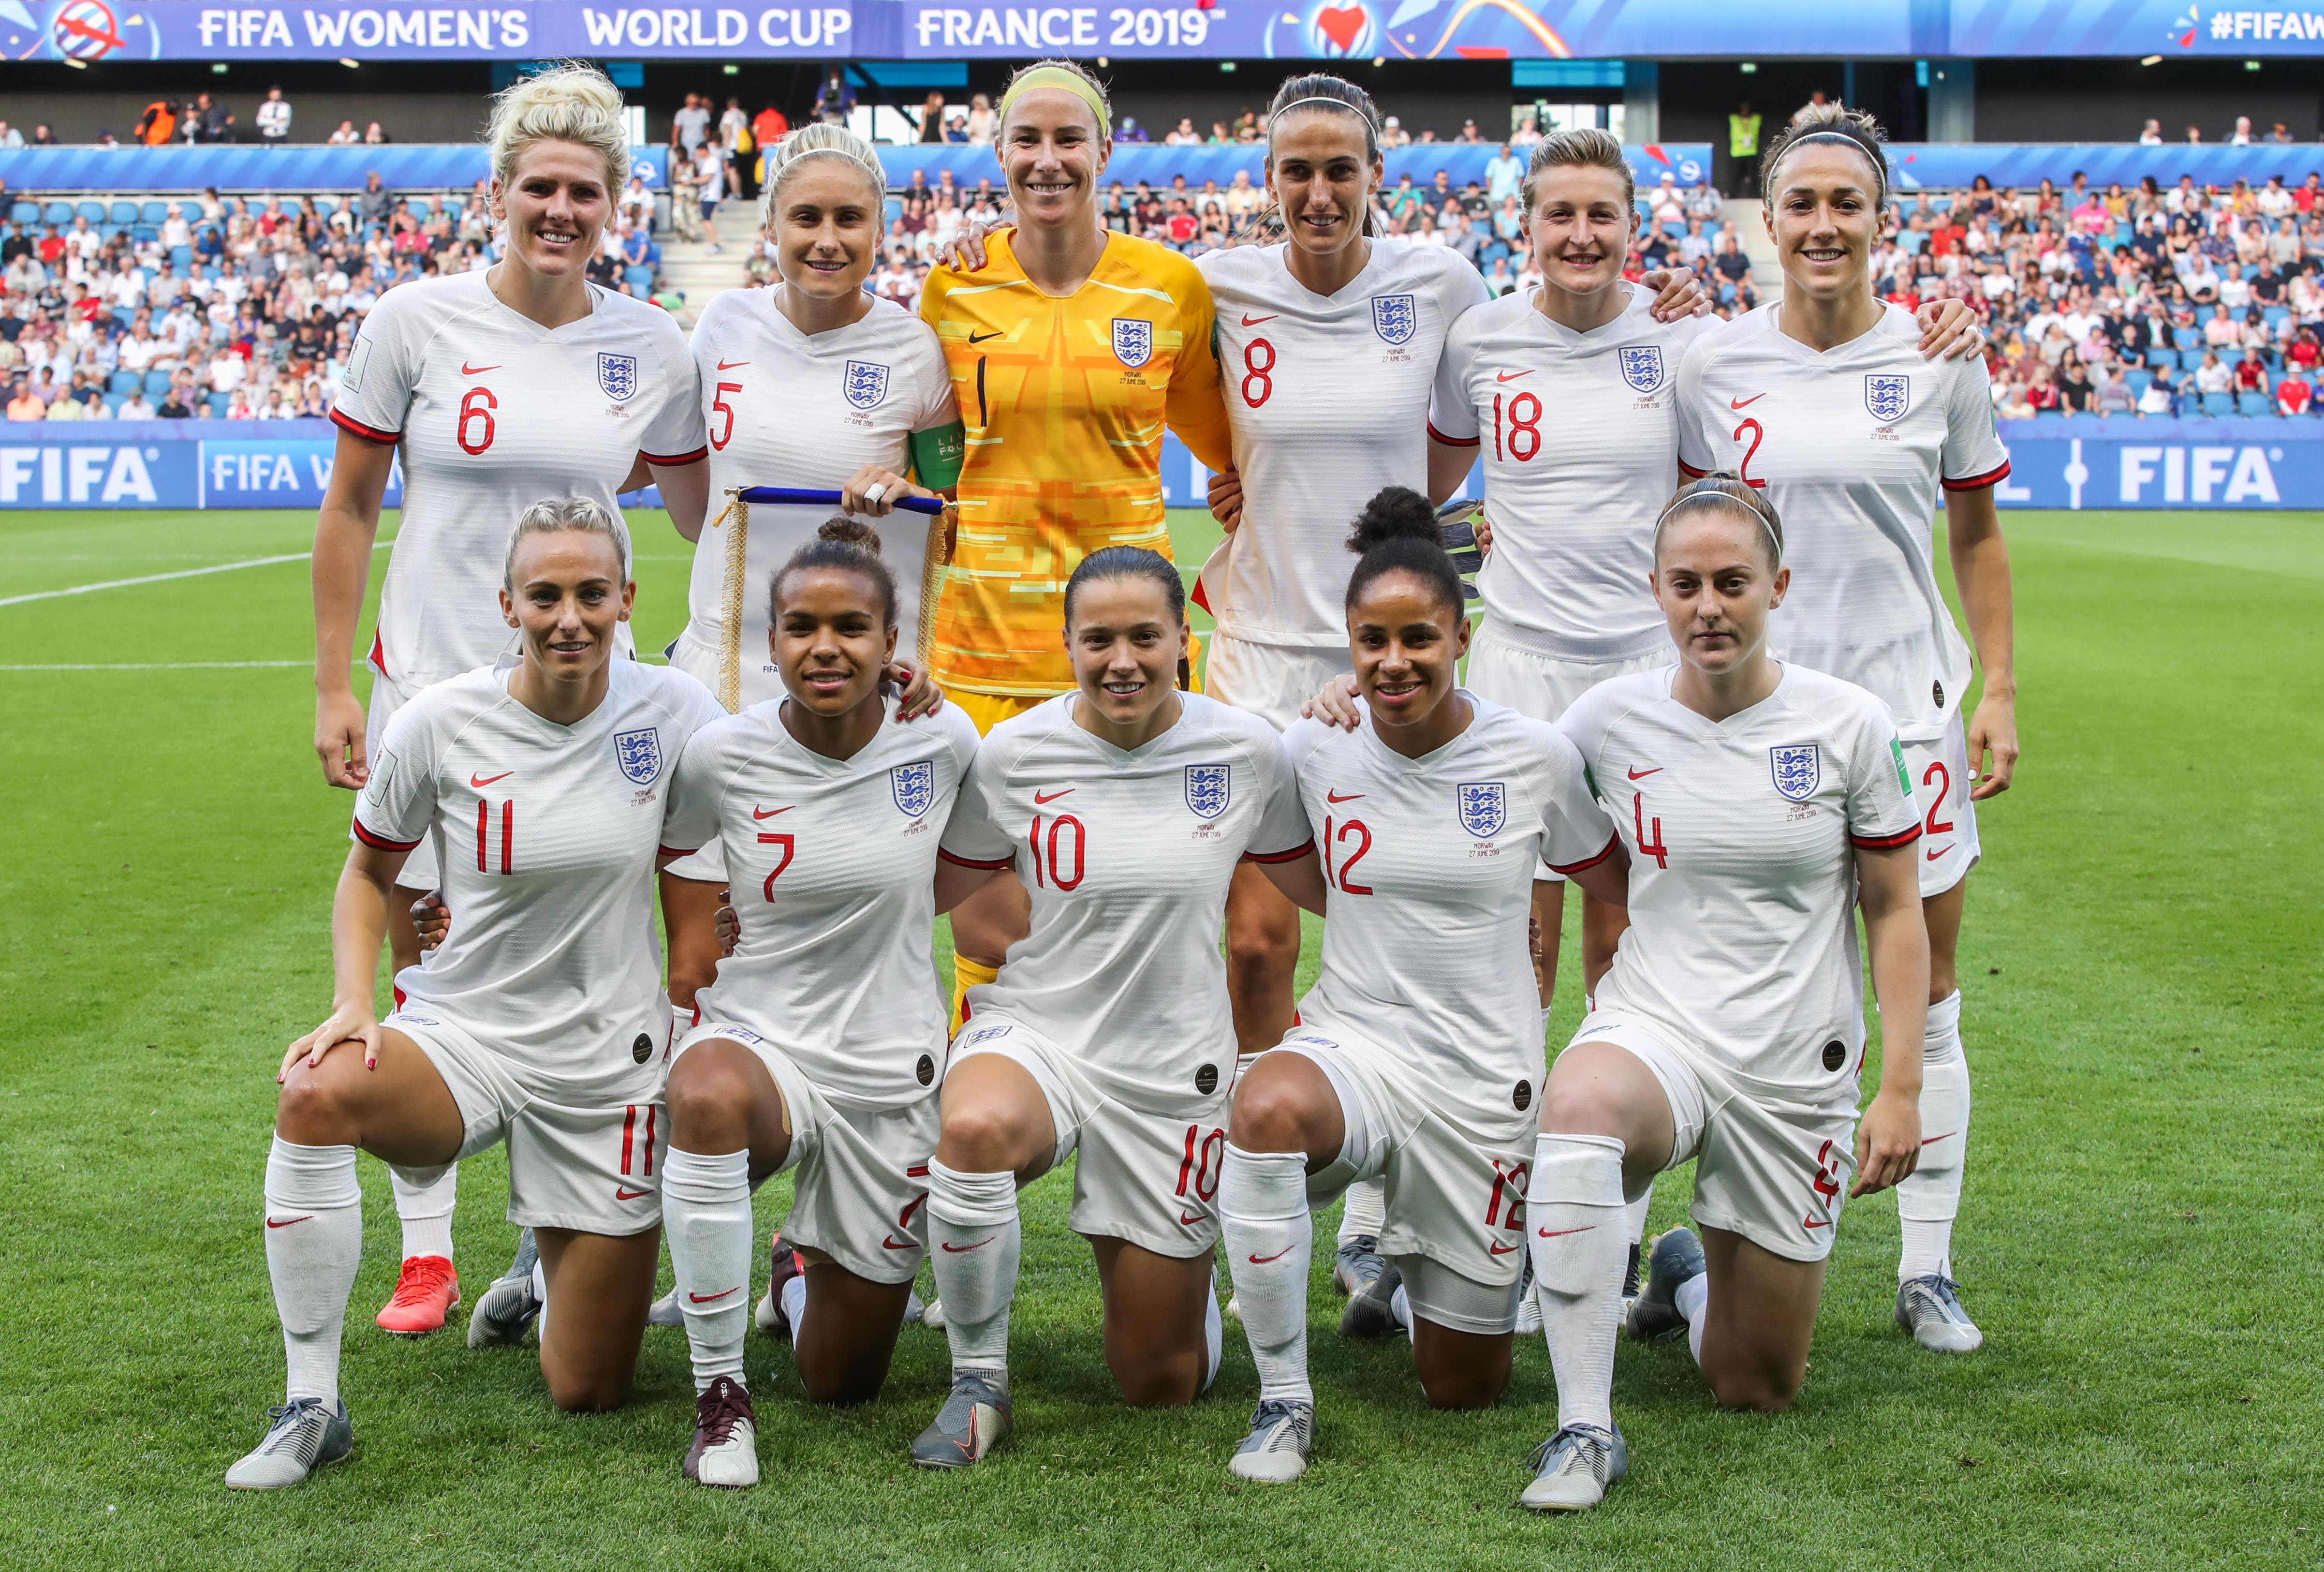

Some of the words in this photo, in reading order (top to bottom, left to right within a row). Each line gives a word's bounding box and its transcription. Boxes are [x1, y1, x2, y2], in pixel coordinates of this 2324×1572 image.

[197, 9, 293, 47] FIFA
[304, 9, 529, 50] WOMEN'S
[582, 8, 749, 46] WORLD
[759, 8, 852, 46] CUP
[915, 8, 1099, 49] FRANCE
[1109, 8, 1208, 46] 2019
[1242, 338, 1276, 409] 8
[457, 386, 498, 456] 6
[710, 382, 744, 451] 5
[1493, 392, 1543, 462] 18
[0, 447, 158, 502] FIFA
[212, 454, 300, 491] FIFA
[1734, 417, 1766, 489] 2
[2120, 447, 2281, 502] FIFA
[1634, 792, 1668, 870] 4
[1923, 761, 1954, 835] 2
[476, 799, 513, 875] 11
[757, 832, 795, 904] 7
[1029, 814, 1086, 892] 10
[1324, 815, 1374, 896] 12
[620, 1104, 656, 1176] 11
[1175, 1124, 1224, 1202] 10
[1813, 1138, 1840, 1210] 4
[1485, 1159, 1528, 1232] 12
